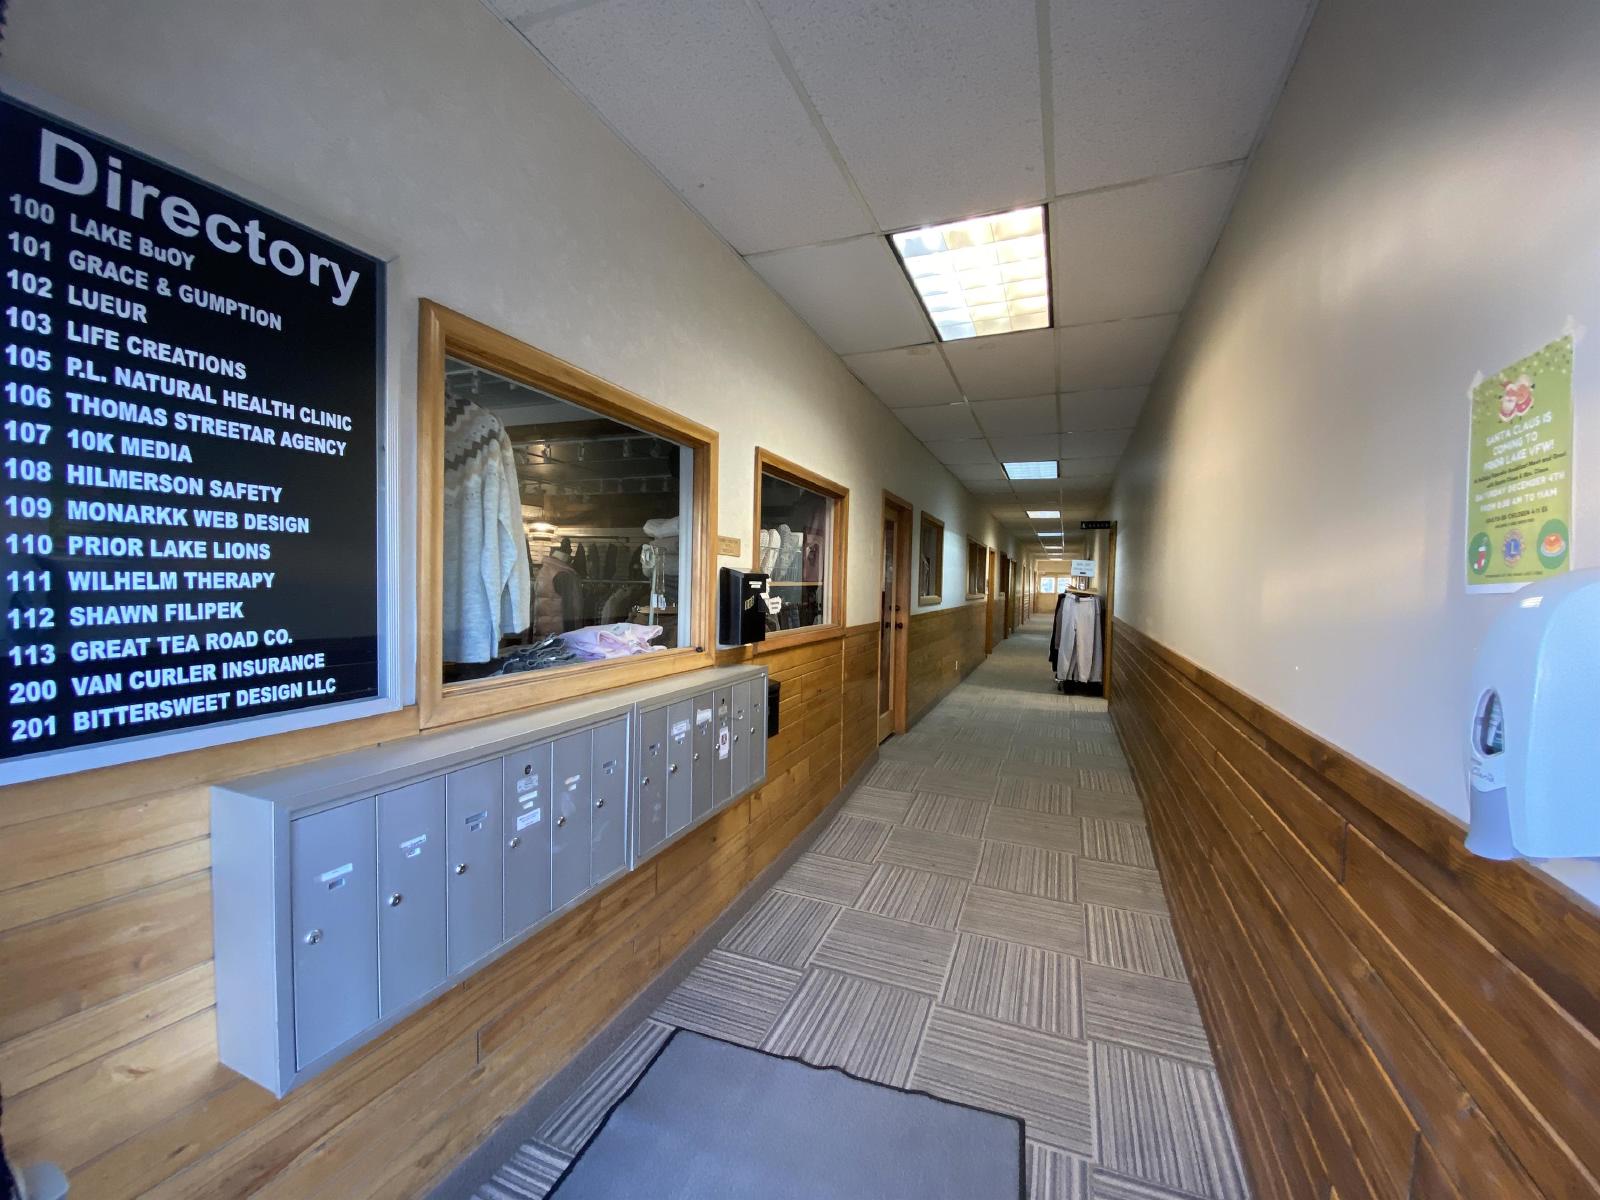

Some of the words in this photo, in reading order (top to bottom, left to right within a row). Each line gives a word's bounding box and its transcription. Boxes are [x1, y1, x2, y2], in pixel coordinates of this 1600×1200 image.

[9, 193, 55, 225] 100
[70, 213, 132, 251] LAKE
[139, 238, 196, 271] BuOY
[39, 128, 360, 307] Directory
[6, 269, 52, 298] 102
[68, 285, 148, 323] LUEUR
[8, 232, 51, 261] 101
[68, 250, 148, 291] GRACE
[156, 278, 172, 297] &
[179, 285, 282, 331] GUMPTION
[6, 307, 52, 335] 103
[67, 321, 119, 351] LIFE
[127, 336, 247, 380] CREATIONS
[5, 345, 51, 372] 105
[67, 357, 107, 383] P.L.
[114, 367, 217, 404] NATURAL
[223, 390, 295, 420] HEALTH
[299, 407, 352, 431] CLINIC
[4, 382, 51, 408] 106
[67, 392, 168, 426] THOMAS
[174, 414, 275, 445] STREETAR
[280, 431, 347, 457] AGENCY
[4, 421, 51, 445] 107
[67, 429, 114, 453] 10K
[121, 437, 193, 462] MEDIA
[4, 458, 51, 482] 108
[67, 465, 204, 496] HILMERSON
[210, 479, 282, 502] SAFETY
[5, 496, 52, 519] 109
[67, 501, 188, 527] MONARKK
[193, 511, 238, 529] WEB
[244, 514, 310, 533] DESIGN
[6, 534, 52, 555] 110
[68, 538, 144, 557] PRIOR
[151, 541, 208, 558] LAKE
[213, 543, 271, 559] LIONS
[6, 572, 51, 592] 111
[68, 572, 178, 591] WILHELM
[184, 572, 275, 590] THERAPY
[7, 608, 55, 630] 112
[69, 605, 158, 627] SHAWN
[165, 602, 244, 621] FILIPEK
[8, 644, 56, 666] 113
[71, 638, 151, 662] GREAT
[157, 634, 199, 654] TEA
[206, 631, 256, 651] ROAD
[264, 629, 293, 645] CO.
[9, 680, 57, 704] 200
[72, 674, 122, 696] VAN
[129, 662, 217, 690] CURLER
[222, 653, 325, 679] INSURANCE
[11, 716, 56, 742] 201
[73, 692, 229, 732] BITTERSWEET
[236, 683, 302, 708] DESIGN
[308, 678, 336, 697] LLC
